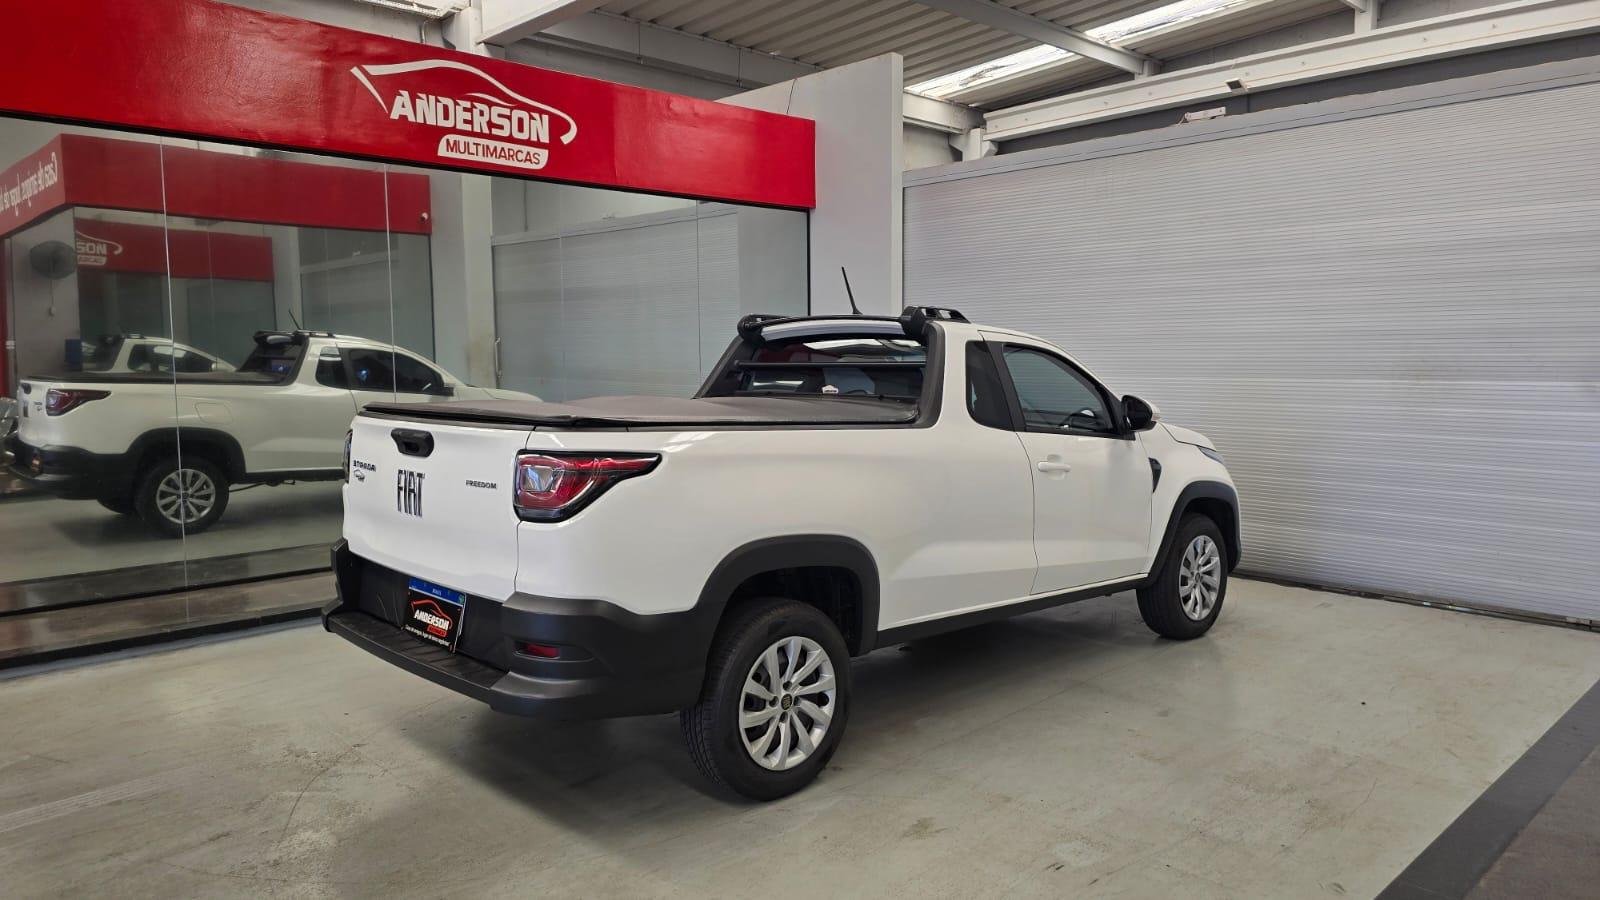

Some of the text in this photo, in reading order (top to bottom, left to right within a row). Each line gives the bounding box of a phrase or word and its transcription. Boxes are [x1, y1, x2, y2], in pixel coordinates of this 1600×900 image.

[390, 90, 550, 144] ANDERSON
[445, 138, 541, 165] MULTIMARCAS
[397, 469, 425, 517] FIAT
[465, 479, 497, 489] FREEDOM
[413, 608, 450, 631] ANDERSON
